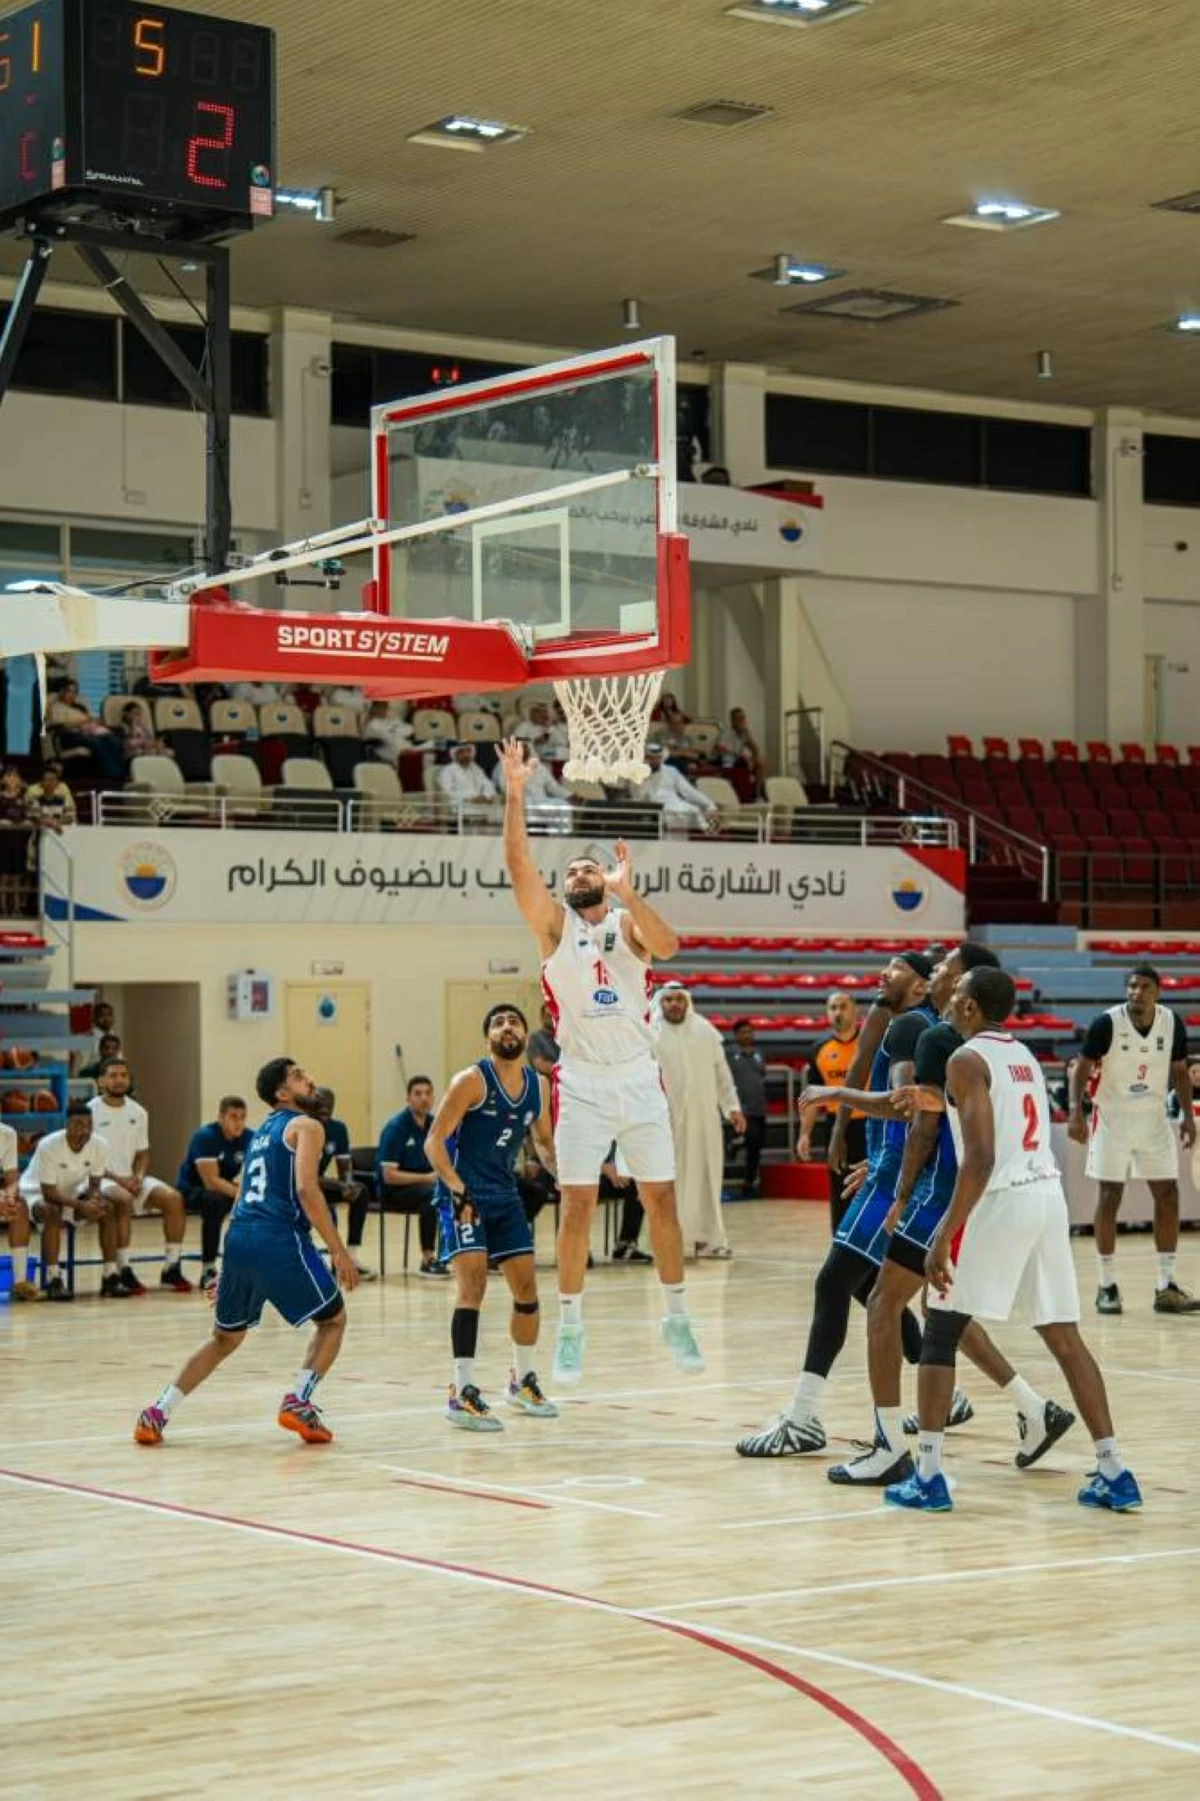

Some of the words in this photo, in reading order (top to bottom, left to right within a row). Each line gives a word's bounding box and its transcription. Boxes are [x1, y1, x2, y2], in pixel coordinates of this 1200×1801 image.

[135, 18, 165, 76] 5
[186, 101, 235, 188] 2
[278, 625, 355, 648] SPORT
[358, 630, 449, 657] SYSTEM
[228, 857, 326, 893] الكرام
[334, 858, 467, 898] بالضيوف
[677, 862, 780, 899] الشارقة
[789, 869, 846, 909] نادي
[496, 1128, 512, 1147] 2
[1022, 1093, 1040, 1152] 2
[244, 1156, 267, 1203] 3
[460, 1223, 476, 1244] 2
